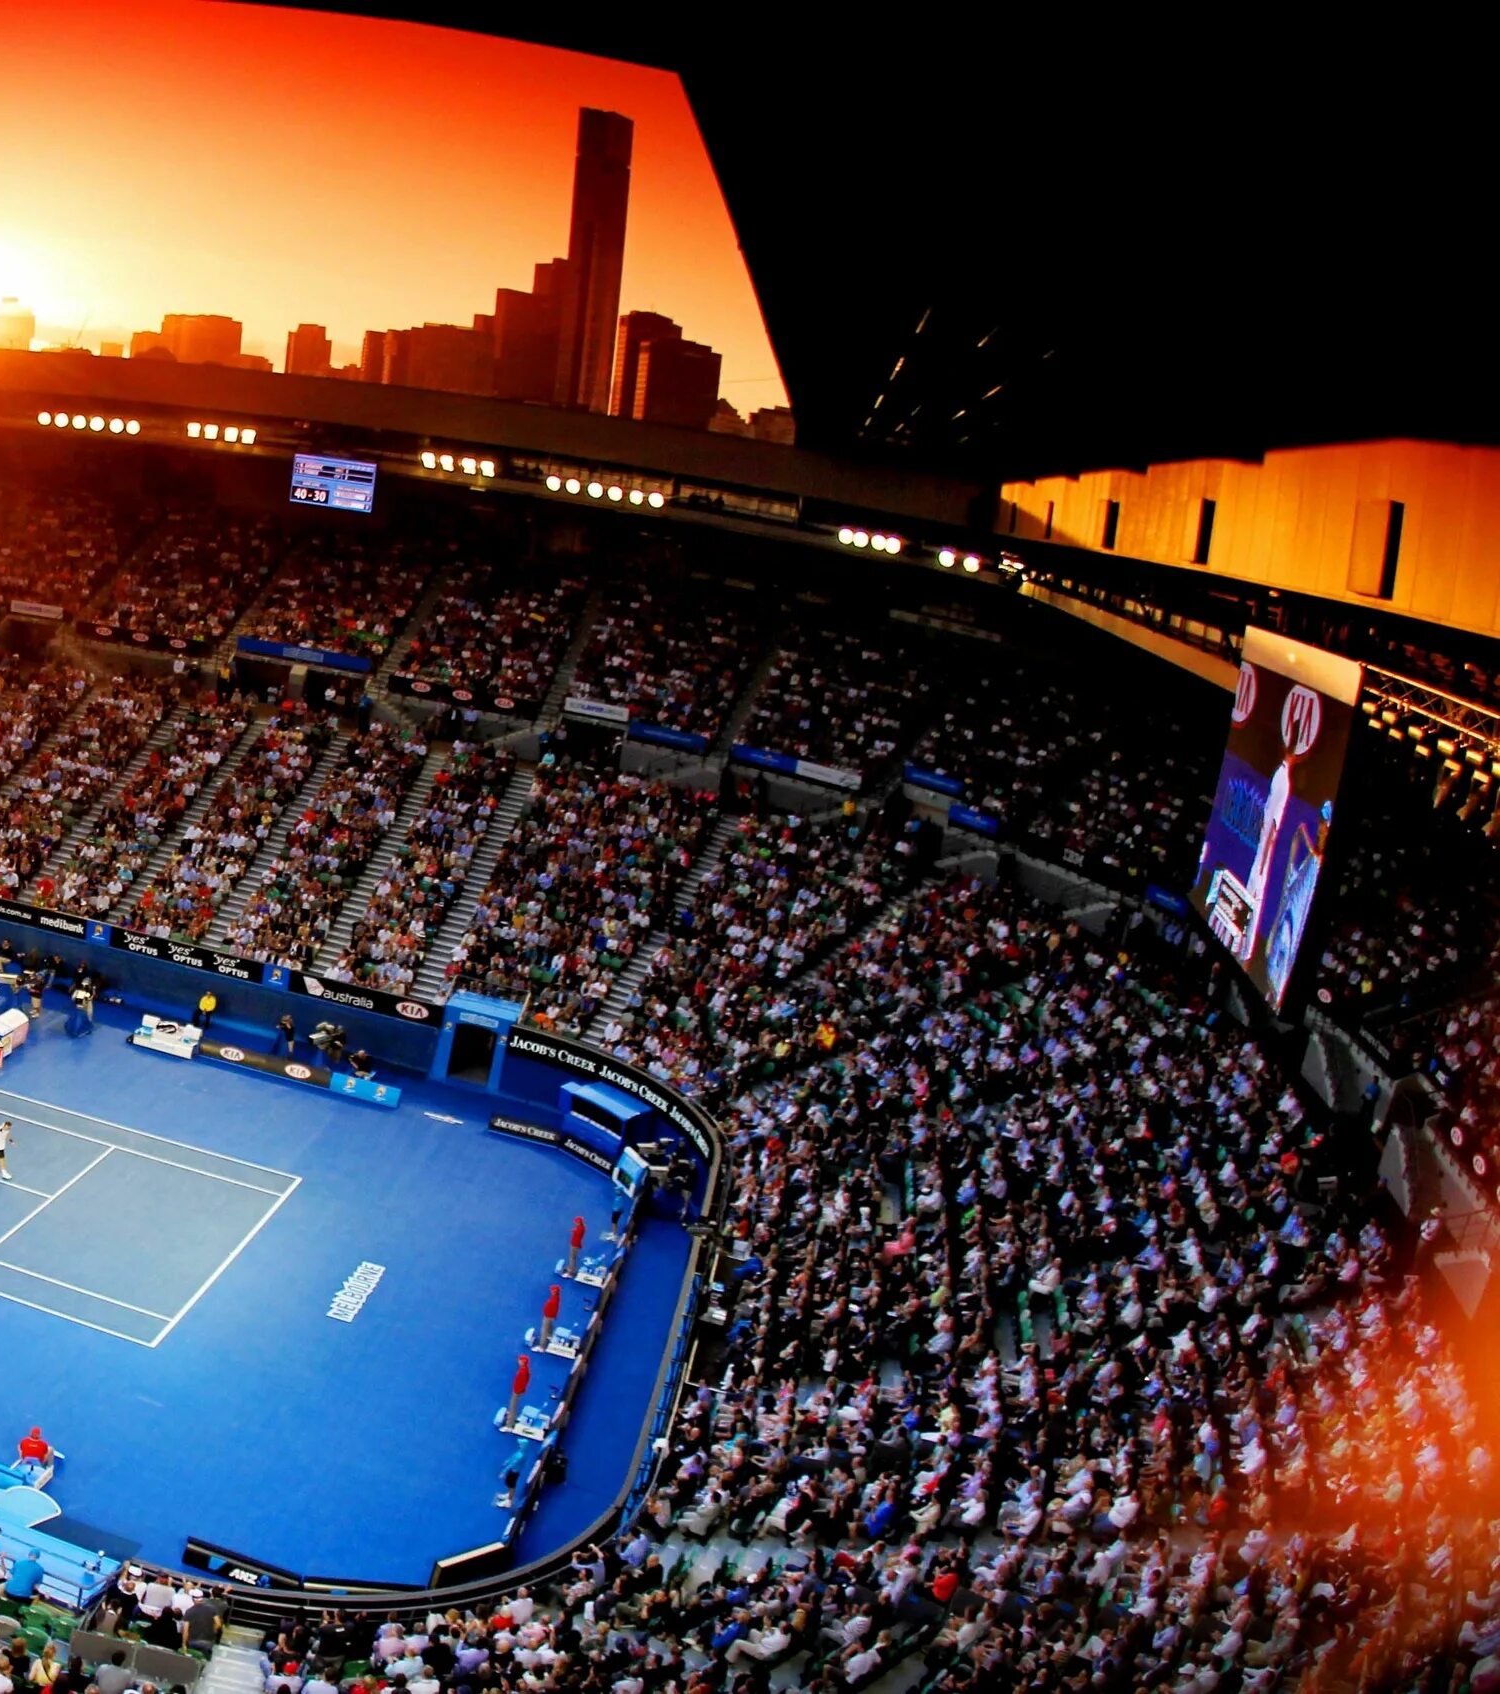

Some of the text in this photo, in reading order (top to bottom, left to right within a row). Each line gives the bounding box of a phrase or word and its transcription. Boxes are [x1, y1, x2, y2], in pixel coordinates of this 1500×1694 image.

[40, 916, 84, 934] medibank
[128, 943, 158, 956] OPTUS
[172, 954, 203, 967] OPTUS
[218, 965, 249, 979] OPTUS
[323, 989, 374, 1009] australia
[400, 1004, 423, 1017] KIA
[510, 1036, 596, 1072] JACOB'S CREEK
[639, 1085, 669, 1112] CREEK
[329, 1262, 384, 1321] MELBOURNE
[228, 1568, 258, 1585] ANZ
